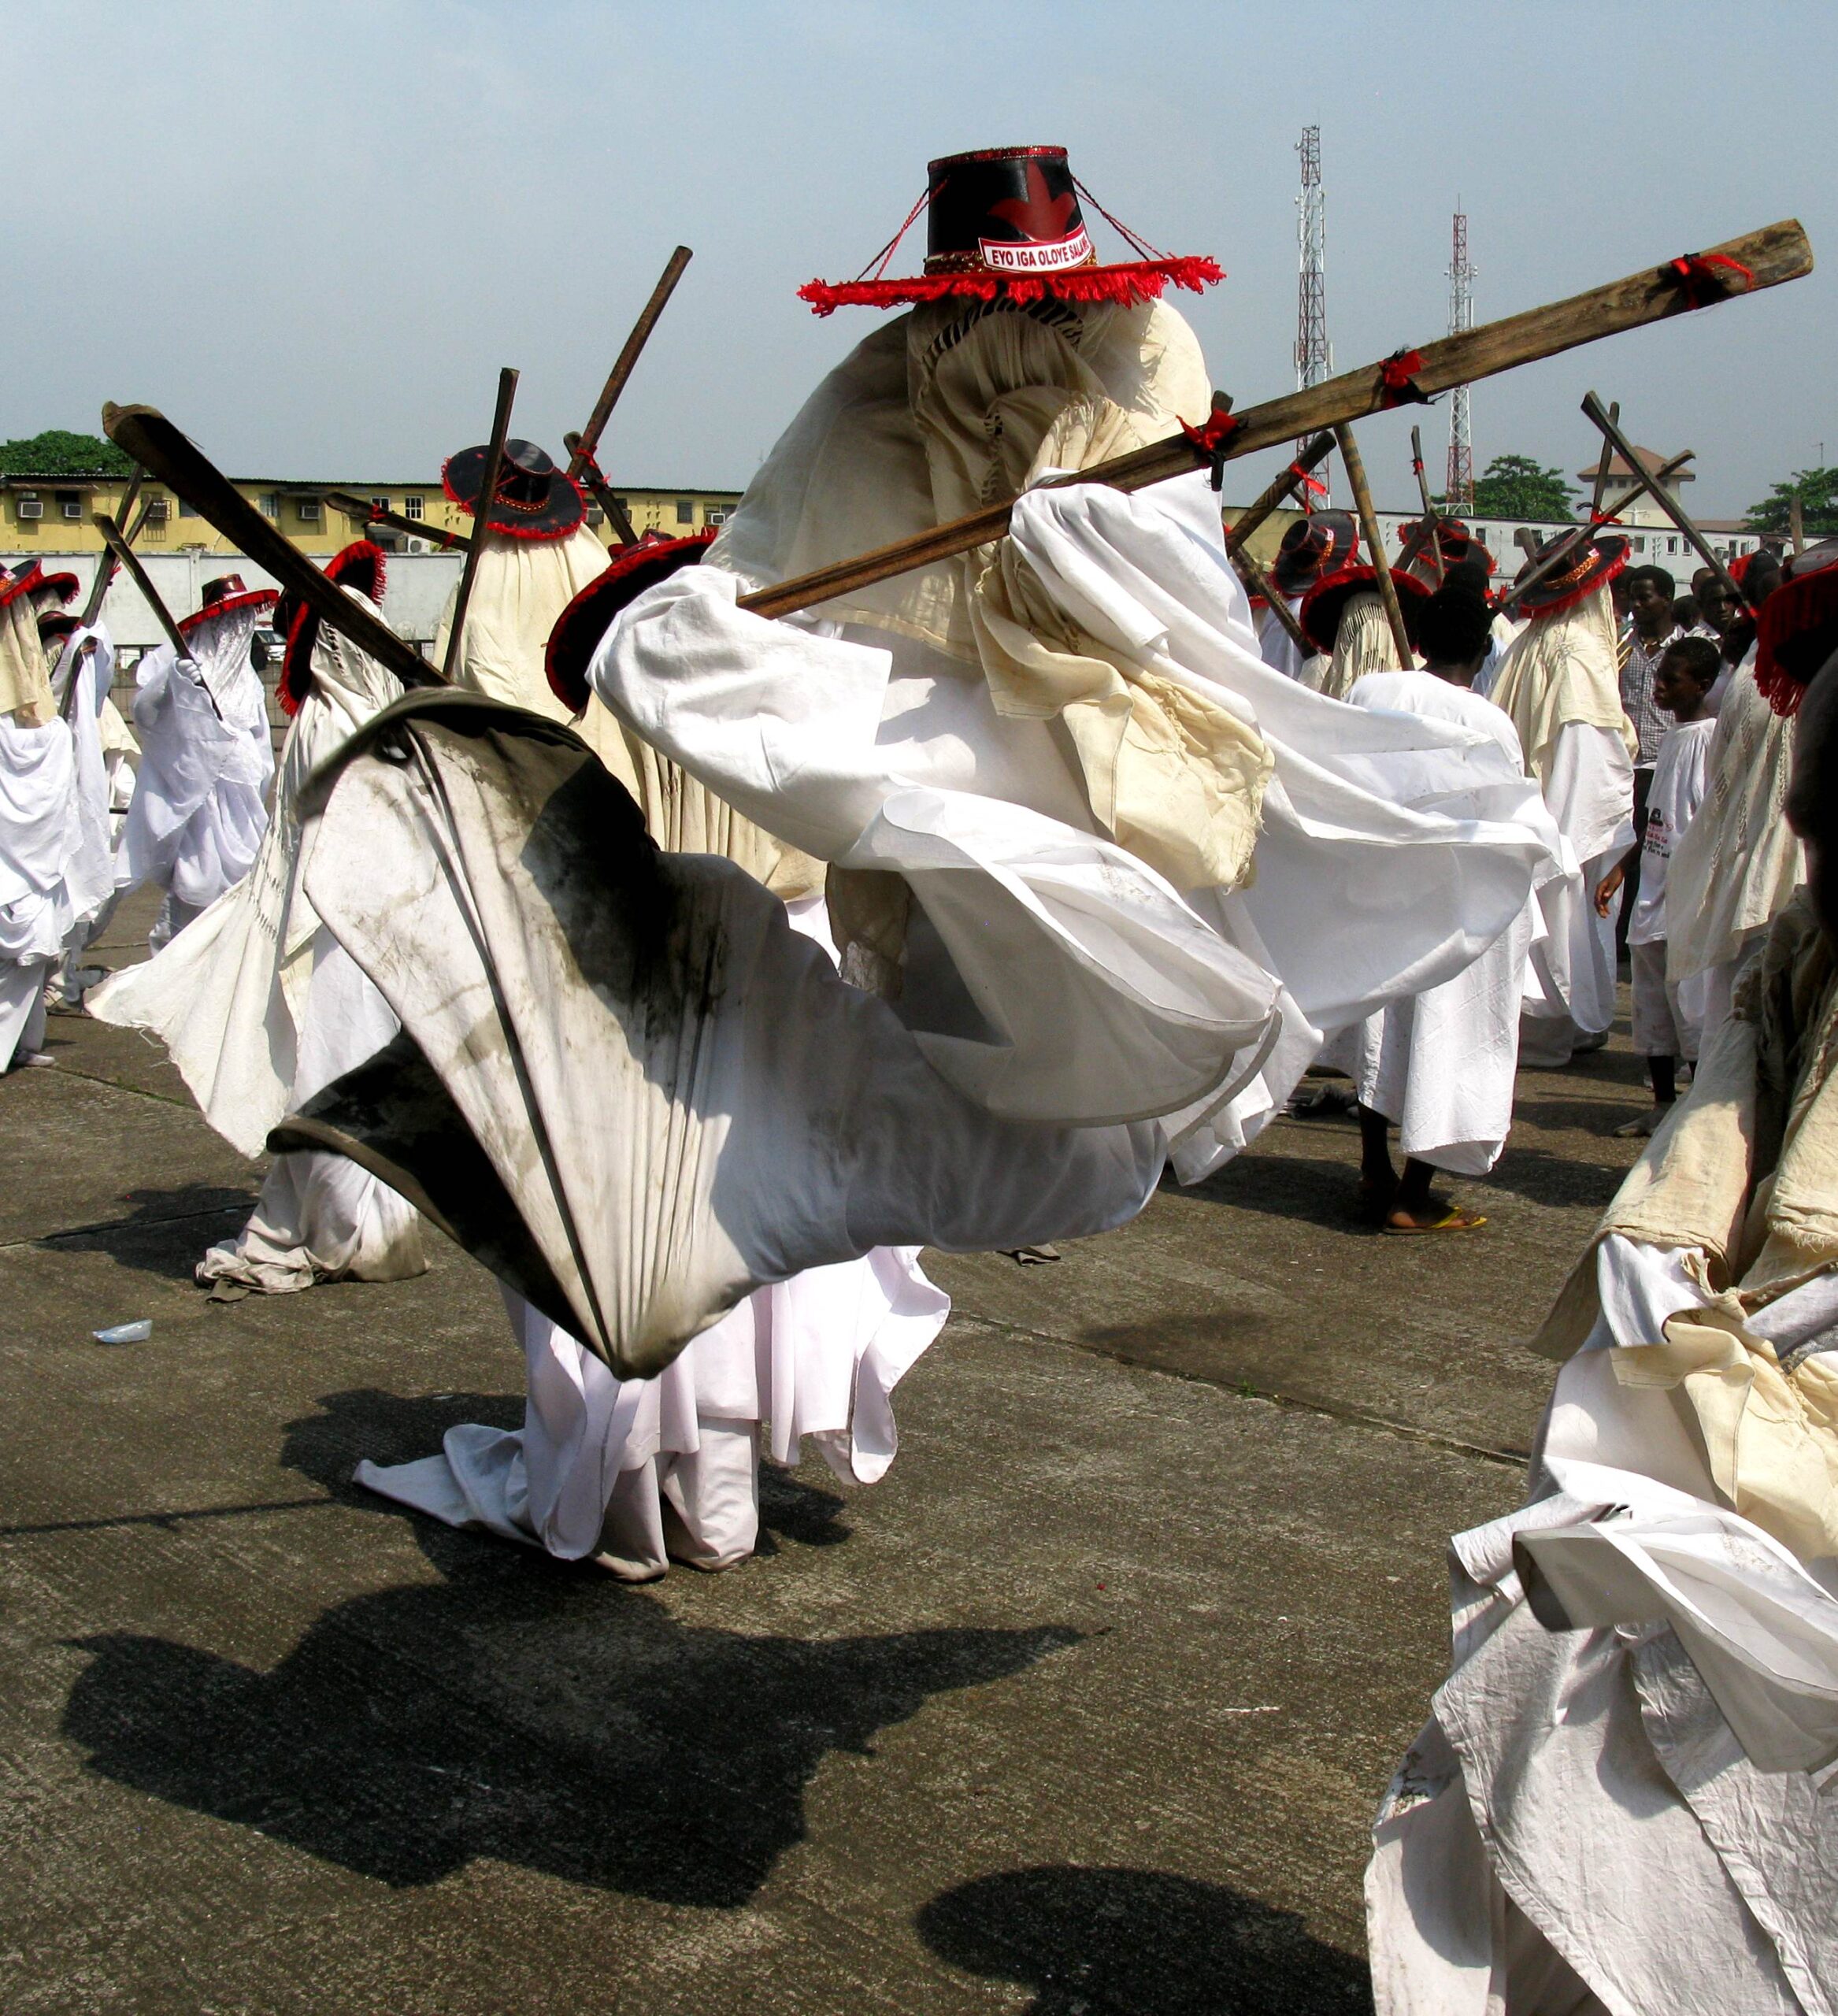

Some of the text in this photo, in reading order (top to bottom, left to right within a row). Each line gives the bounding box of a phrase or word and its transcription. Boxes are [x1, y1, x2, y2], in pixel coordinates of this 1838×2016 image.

[992, 250, 1013, 266] EYO
[1017, 251, 1036, 266] IGA
[1039, 246, 1069, 265] OLOYE
